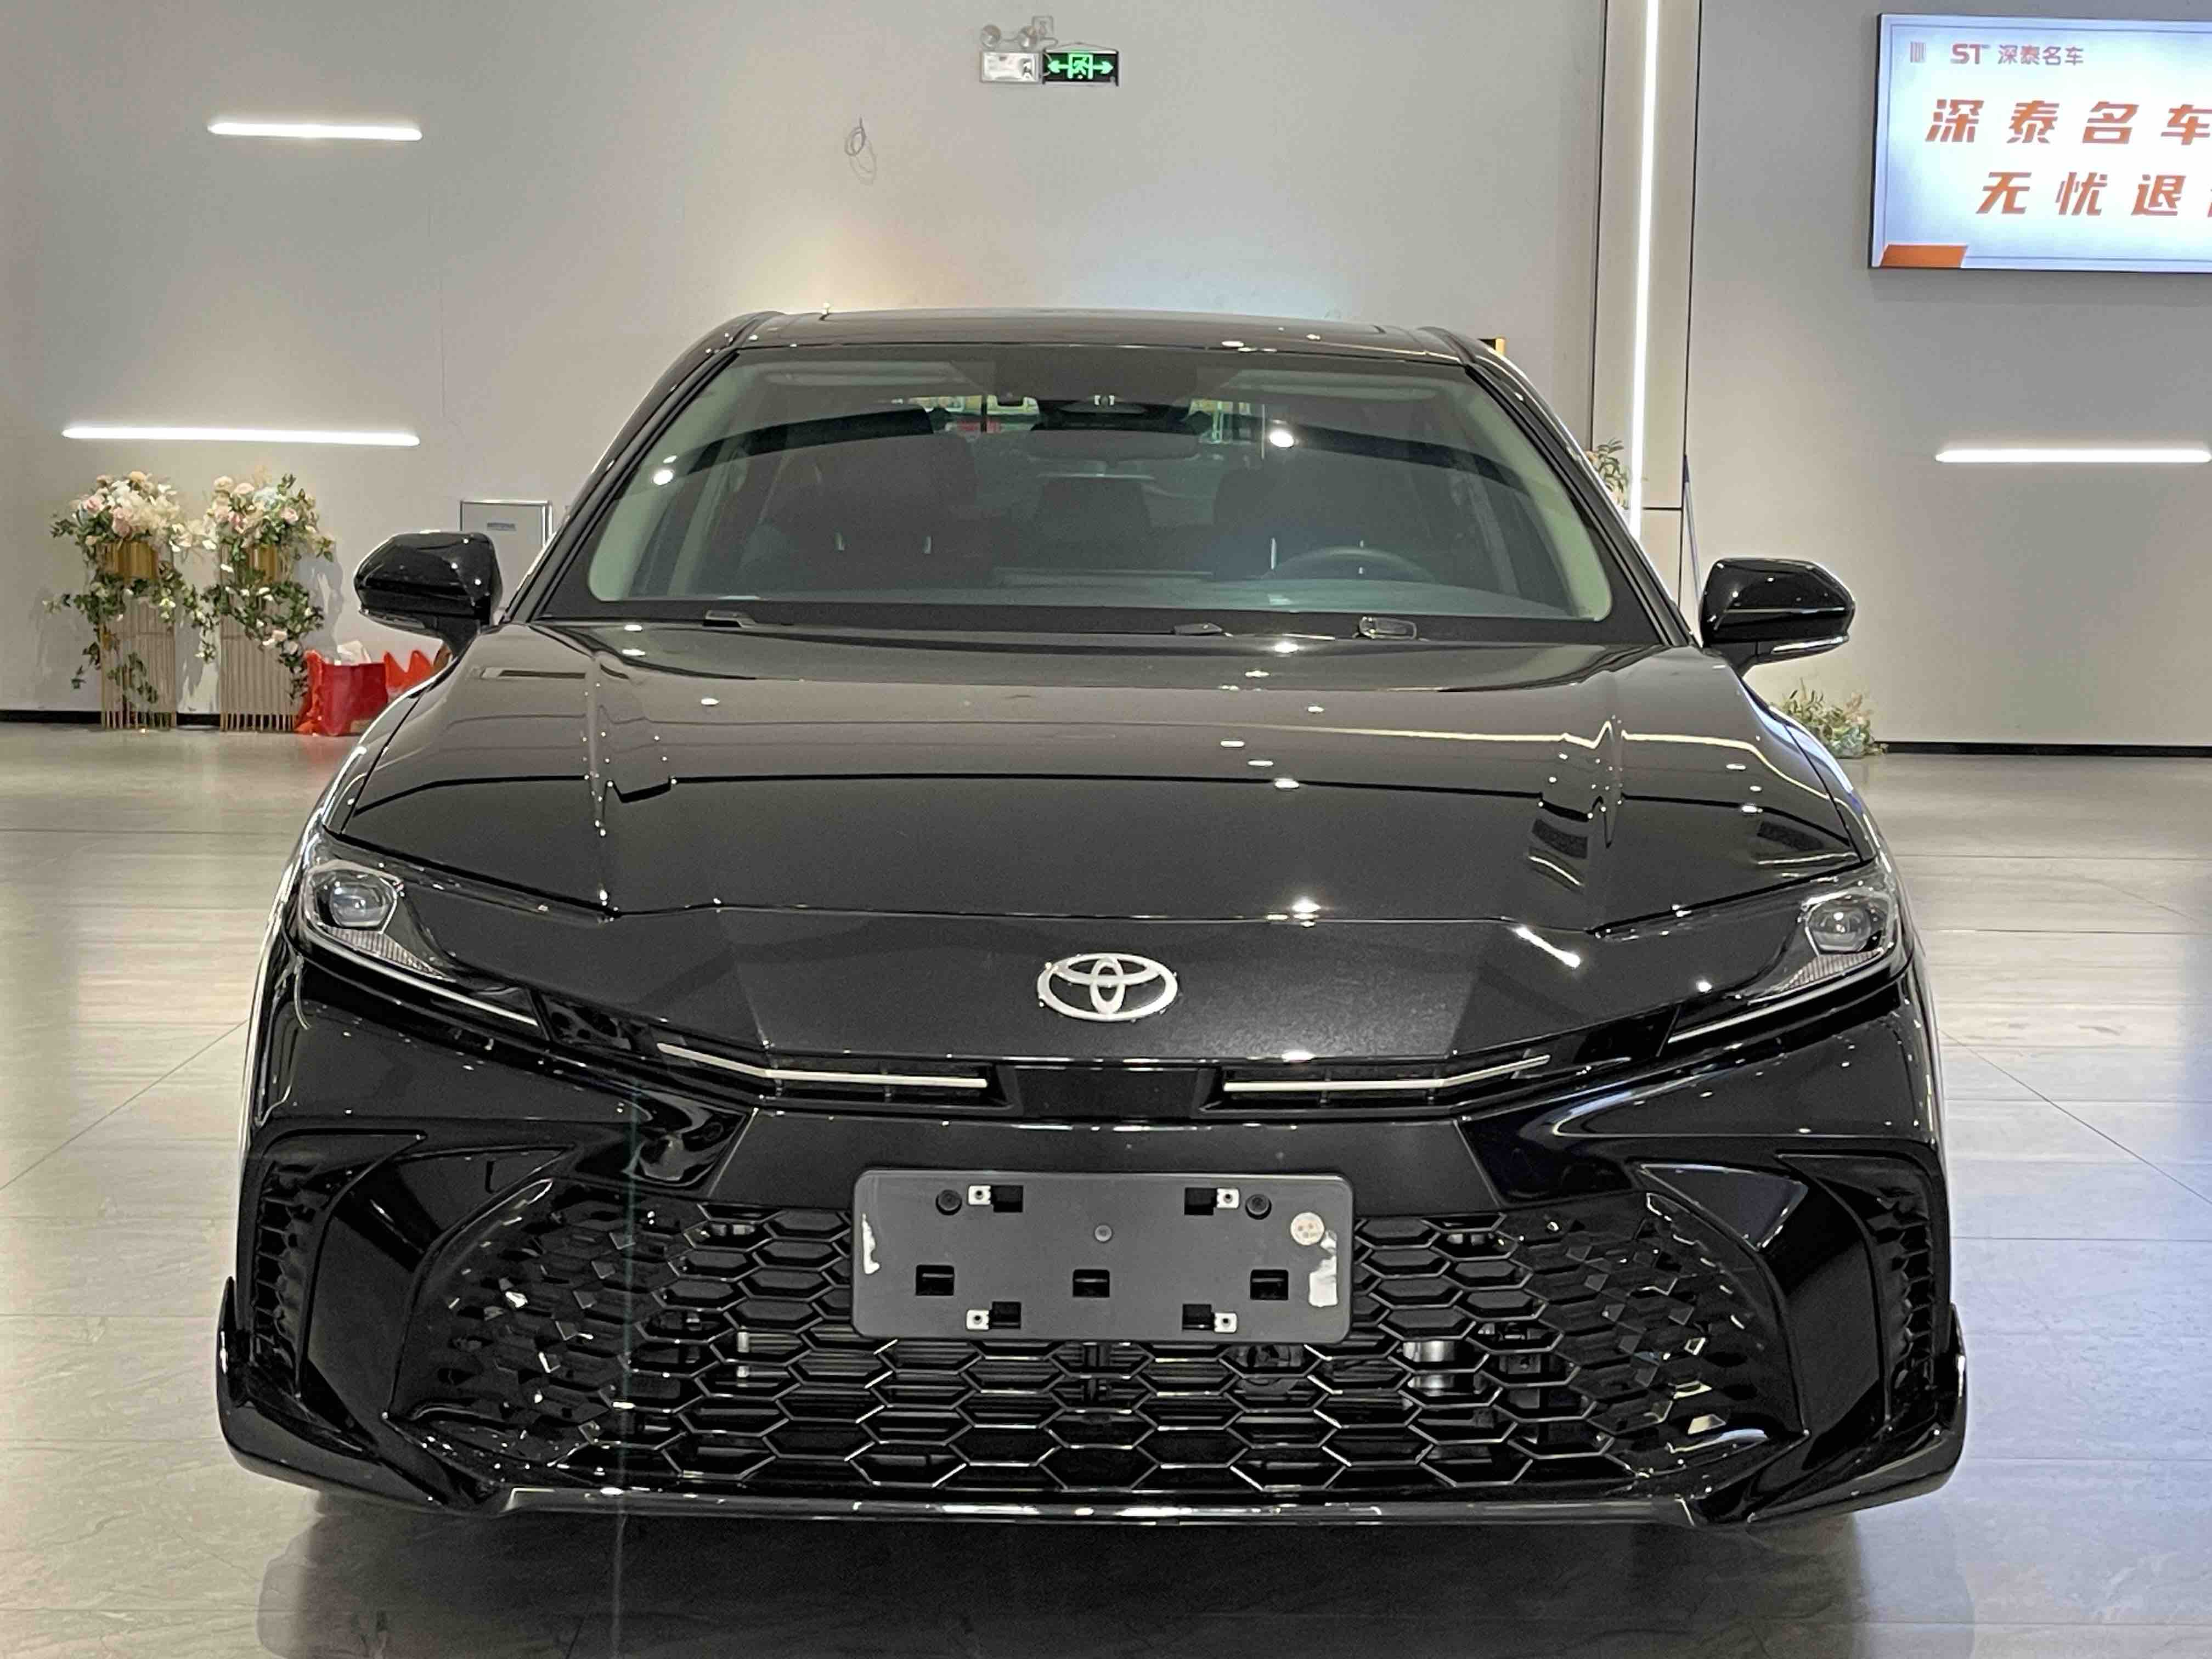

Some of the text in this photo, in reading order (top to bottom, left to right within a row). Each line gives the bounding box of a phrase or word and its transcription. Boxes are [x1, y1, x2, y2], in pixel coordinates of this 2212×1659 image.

[1950, 43, 2084, 65] ST 深泰名车
[1925, 99, 2212, 145] 深泰名车
[1976, 172, 2212, 218] 无忧退
